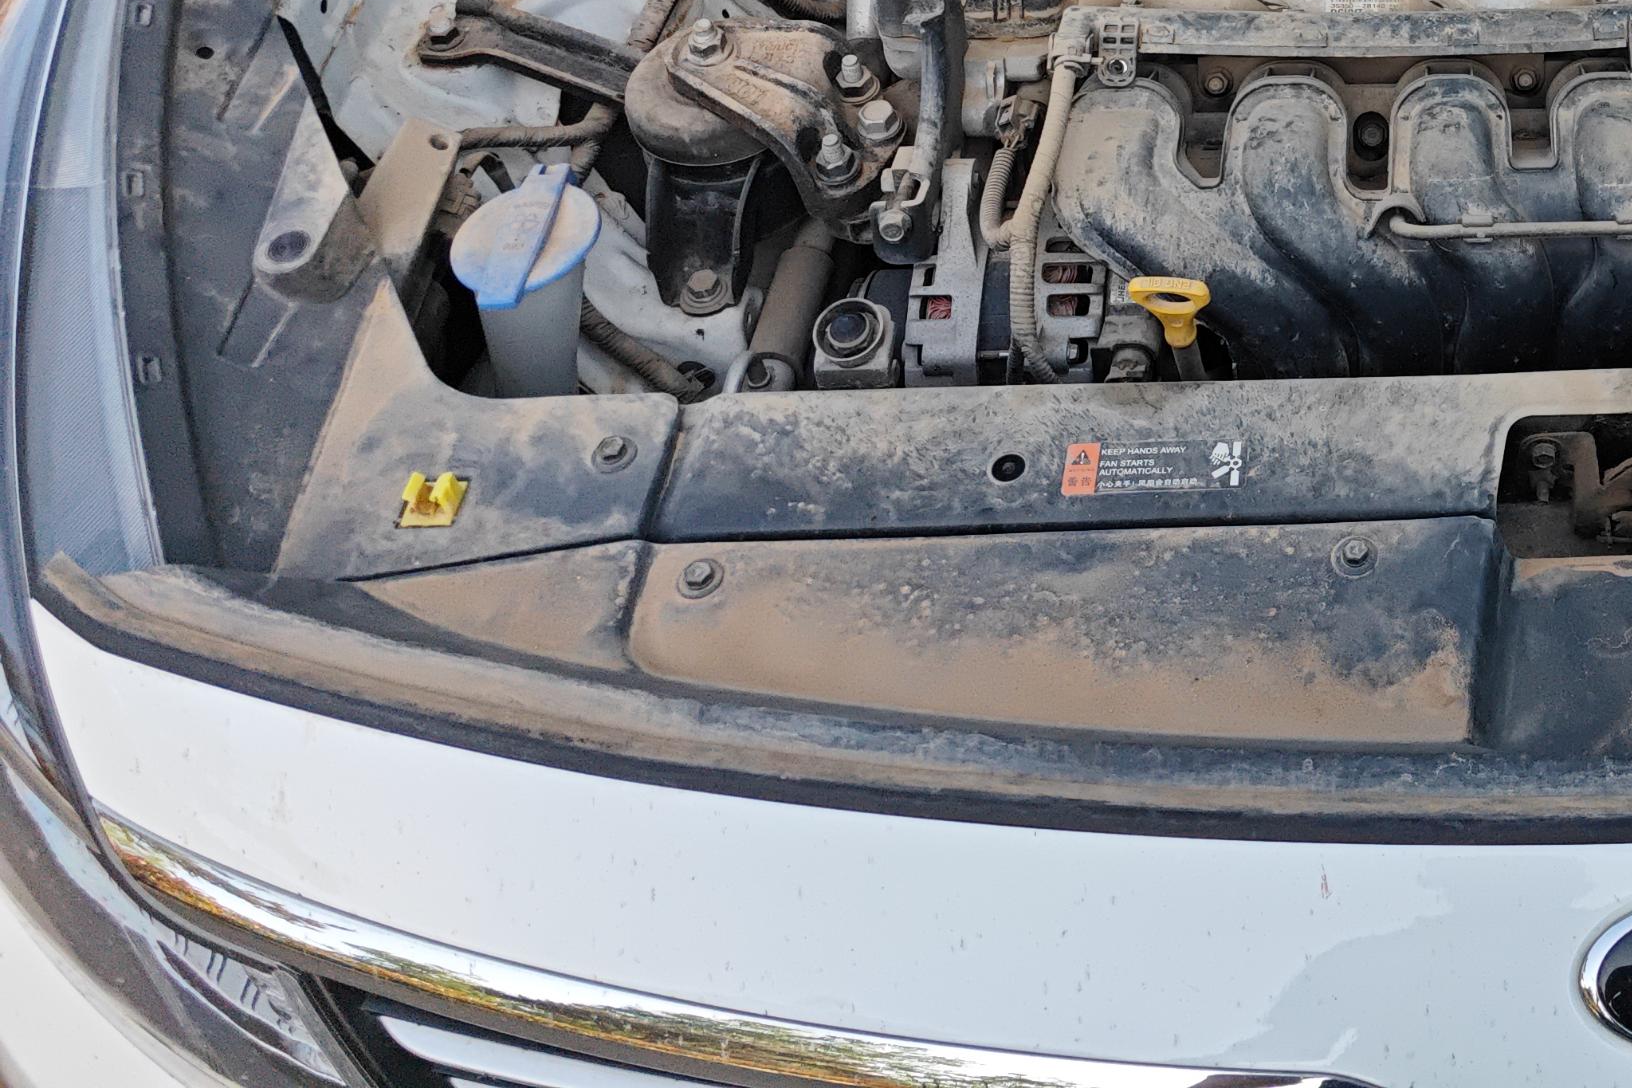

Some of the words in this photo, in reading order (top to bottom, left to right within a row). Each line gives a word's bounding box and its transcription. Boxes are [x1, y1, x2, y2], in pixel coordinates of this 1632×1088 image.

[1100, 447, 1126, 456] KEEP
[1127, 447, 1158, 455] HANDS
[1159, 446, 1187, 454] AWAY
[1099, 460, 1118, 468] FAN
[1119, 459, 1155, 467] STARTS
[1098, 467, 1174, 477] AUTOMATICALLY
